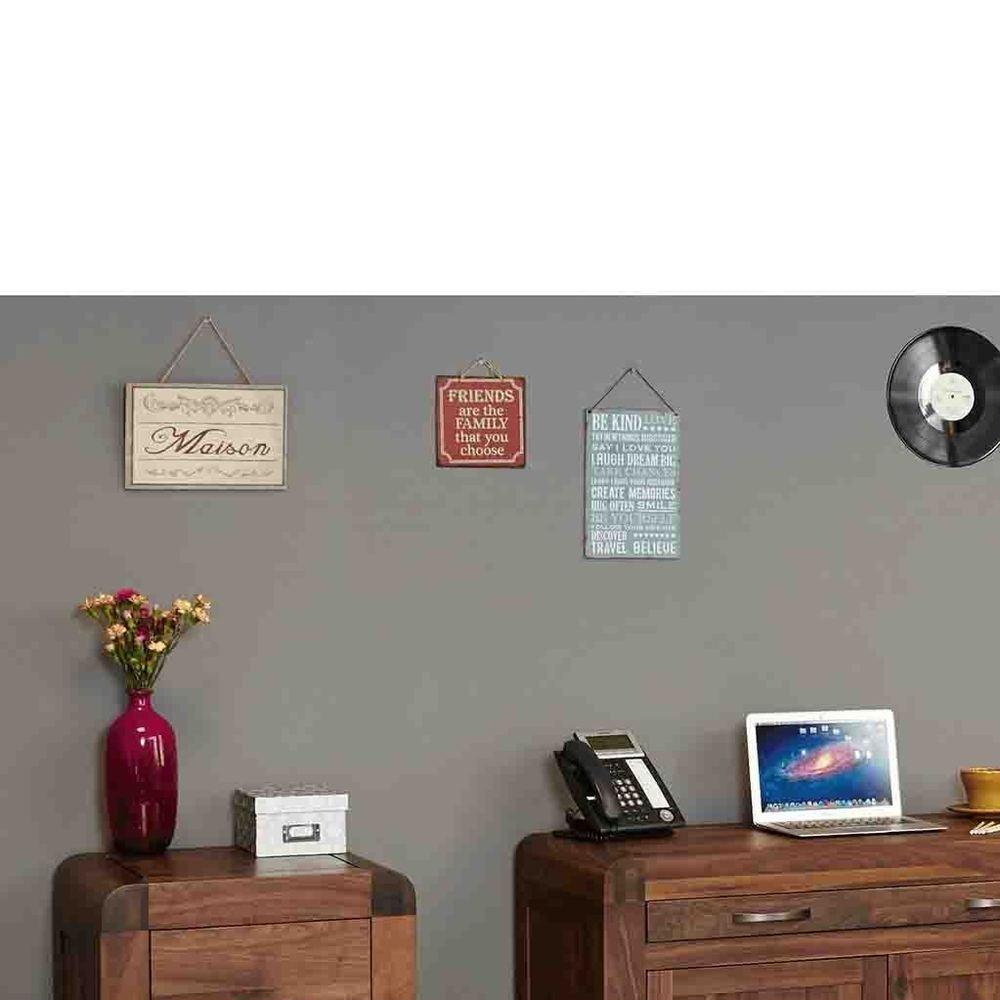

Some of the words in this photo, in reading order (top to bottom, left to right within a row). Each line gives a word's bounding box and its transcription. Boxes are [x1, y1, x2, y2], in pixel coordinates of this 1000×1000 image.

[448, 389, 515, 402] FRIENDS
[459, 407, 480, 416] are
[483, 404, 504, 416] the
[455, 417, 509, 430] FAMILY
[592, 413, 608, 431] BE
[612, 413, 642, 431] KIND
[144, 426, 271, 455] Maison
[455, 430, 480, 442] that
[484, 432, 509, 447] you
[460, 444, 505, 456] choose
[591, 451, 625, 467] LAUGH
[627, 452, 659, 467] DREAM
[590, 486, 625, 500] CREATE
[628, 487, 677, 501] MEMORIES
[591, 541, 627, 557] TRAVEL
[632, 540, 677, 555] BELIEVE
